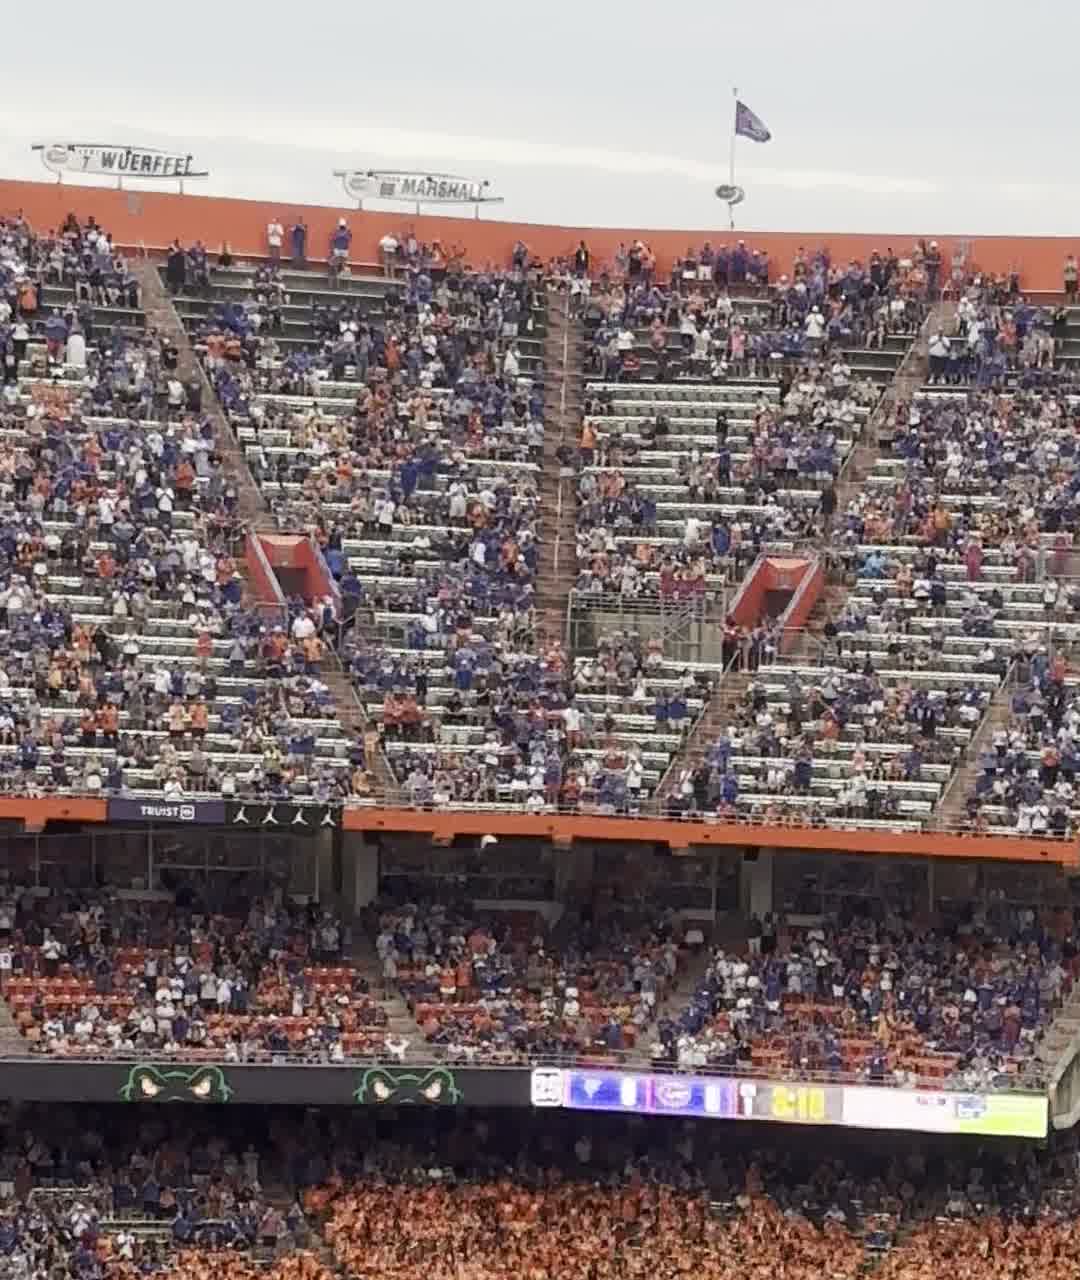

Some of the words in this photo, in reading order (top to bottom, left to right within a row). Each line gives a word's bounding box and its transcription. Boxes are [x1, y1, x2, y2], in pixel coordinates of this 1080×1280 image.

[101, 150, 193, 176] WUERFFEL
[401, 178, 484, 200] MARSHALL
[141, 806, 178, 817] TRUIST
